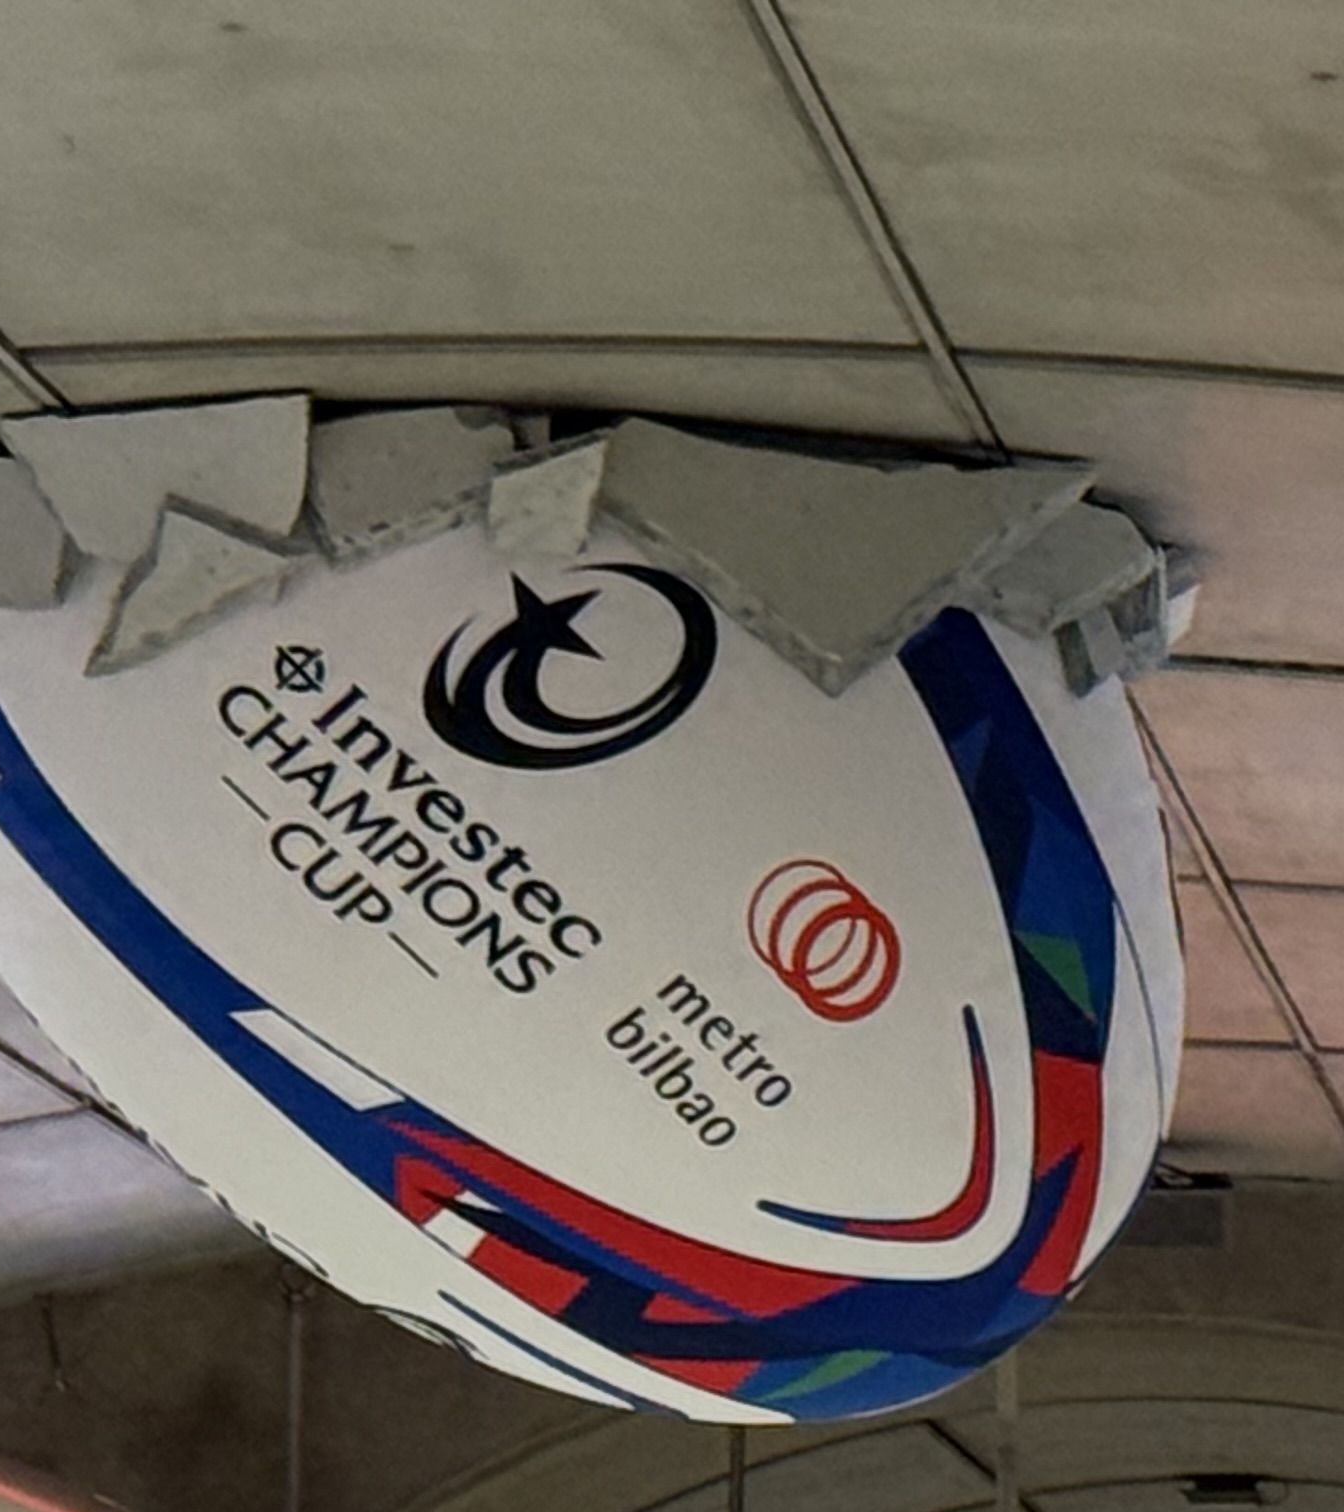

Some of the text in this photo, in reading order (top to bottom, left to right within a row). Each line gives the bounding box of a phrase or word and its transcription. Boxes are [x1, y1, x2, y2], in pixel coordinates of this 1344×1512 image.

[216, 683, 557, 996] CHAMPIONS
[268, 821, 395, 927] CUP
[309, 682, 604, 960] Investec
[605, 1005, 738, 1149] bilbao
[655, 973, 793, 1109] metro
